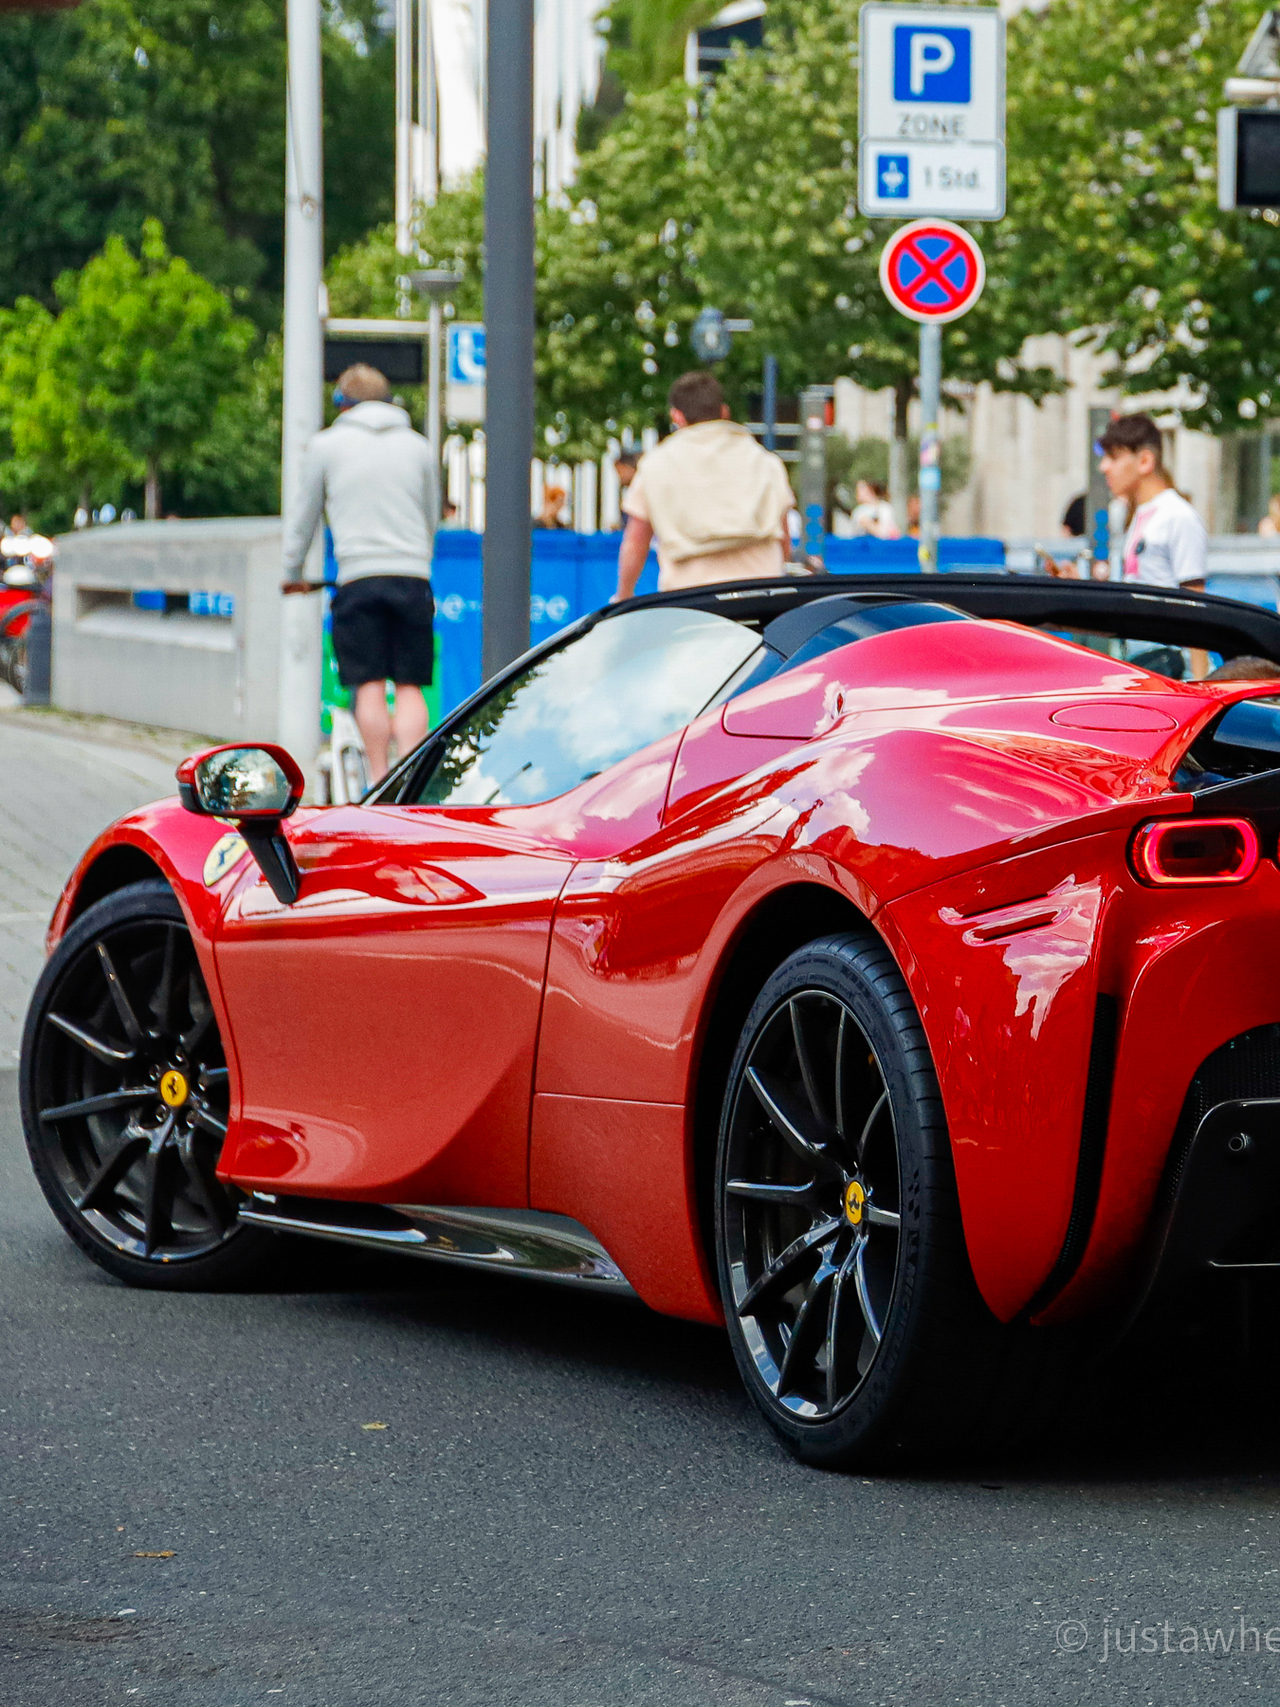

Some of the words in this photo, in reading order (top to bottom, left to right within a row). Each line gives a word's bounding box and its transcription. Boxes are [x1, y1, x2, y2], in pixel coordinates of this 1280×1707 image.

[910, 32, 956, 95] P
[899, 113, 966, 136] ZONE
[923, 165, 932, 189] 1
